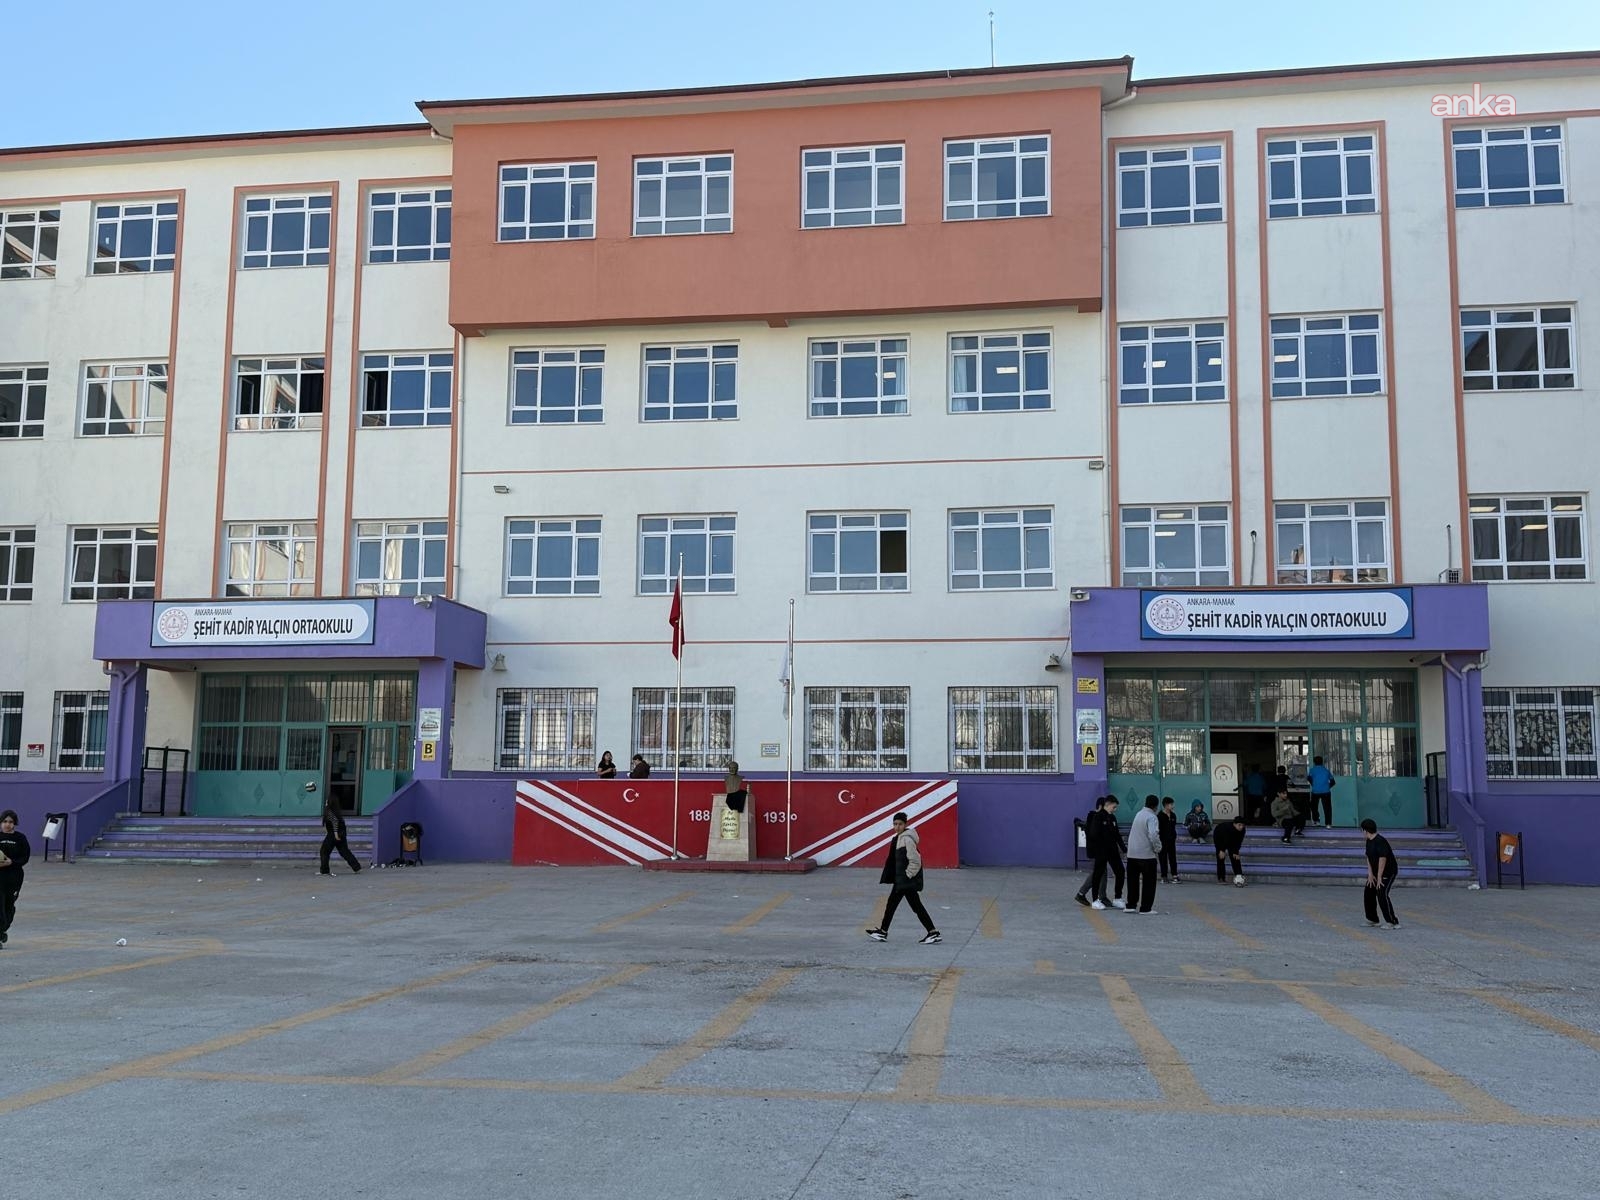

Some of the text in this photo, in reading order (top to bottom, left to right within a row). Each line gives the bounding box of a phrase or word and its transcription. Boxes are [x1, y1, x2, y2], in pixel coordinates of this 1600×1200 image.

[1187, 597, 1235, 606] ANKARA-MAMAK
[194, 608, 232, 616] ANKARA-MAMAK
[1187, 611, 1221, 631] ŞEHİT
[1224, 610, 1263, 628] KADİR
[1264, 613, 1308, 632] YALÇIN
[1310, 611, 1387, 628] ORTAOKULU
[193, 618, 222, 639] ŞEHİT
[224, 617, 254, 635] KADİR
[256, 619, 290, 638] YALÇIN
[292, 618, 353, 635] ORTAOKULU
[425, 743, 432, 754] B
[1084, 746, 1094, 758] A
[689, 810, 712, 822] 188
